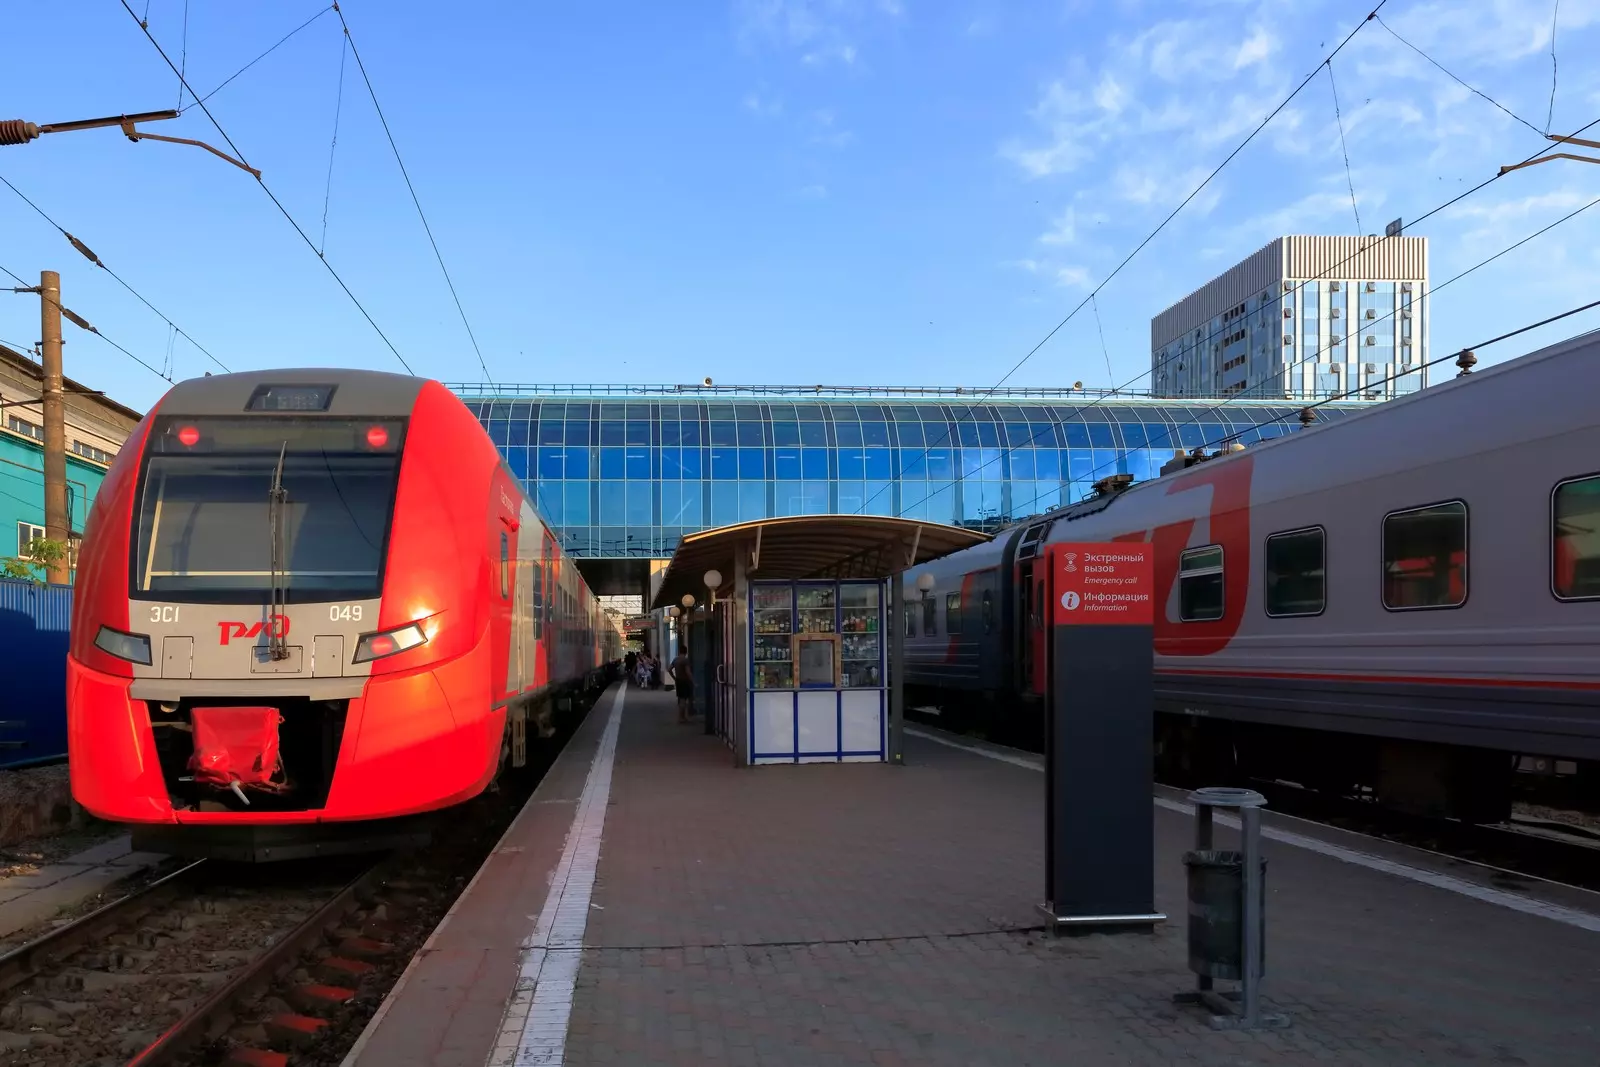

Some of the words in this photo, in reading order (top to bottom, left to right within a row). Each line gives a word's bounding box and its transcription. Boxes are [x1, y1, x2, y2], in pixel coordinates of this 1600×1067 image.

[1084, 552, 1144, 564] Экстренный
[1084, 565, 1115, 573] вызов
[1084, 576, 1123, 585] Emergency
[1124, 576, 1138, 584] call
[1084, 592, 1149, 603] Информация
[1084, 603, 1128, 612] Information
[329, 605, 363, 622] 049
